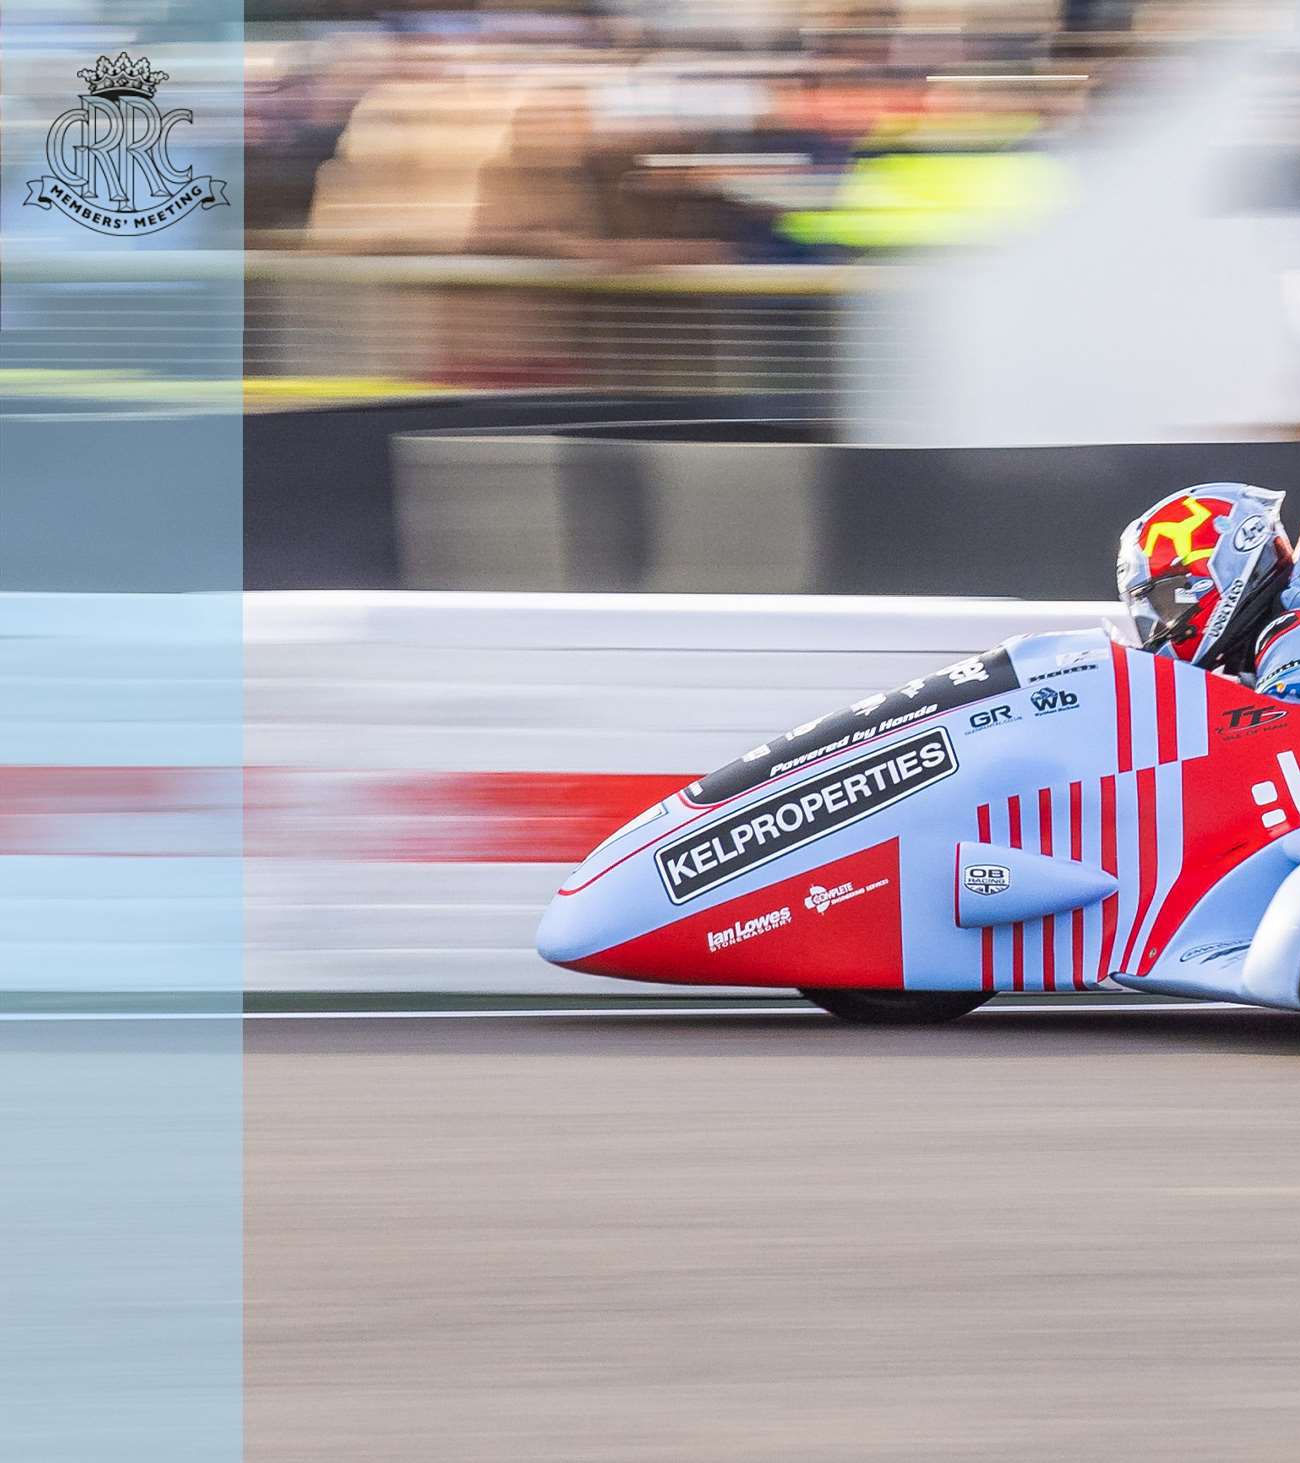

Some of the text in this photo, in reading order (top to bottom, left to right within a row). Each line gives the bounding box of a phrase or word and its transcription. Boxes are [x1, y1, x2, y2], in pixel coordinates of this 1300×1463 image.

[969, 704, 1013, 729] GR
[769, 735, 851, 778] Powered
[852, 725, 877, 744] by
[878, 703, 939, 732] Honda
[666, 742, 946, 886] KELPROPERTIES
[970, 868, 1004, 878] OB
[707, 906, 792, 947] Ian Lowes
[709, 917, 793, 952] STONEMASONRY
